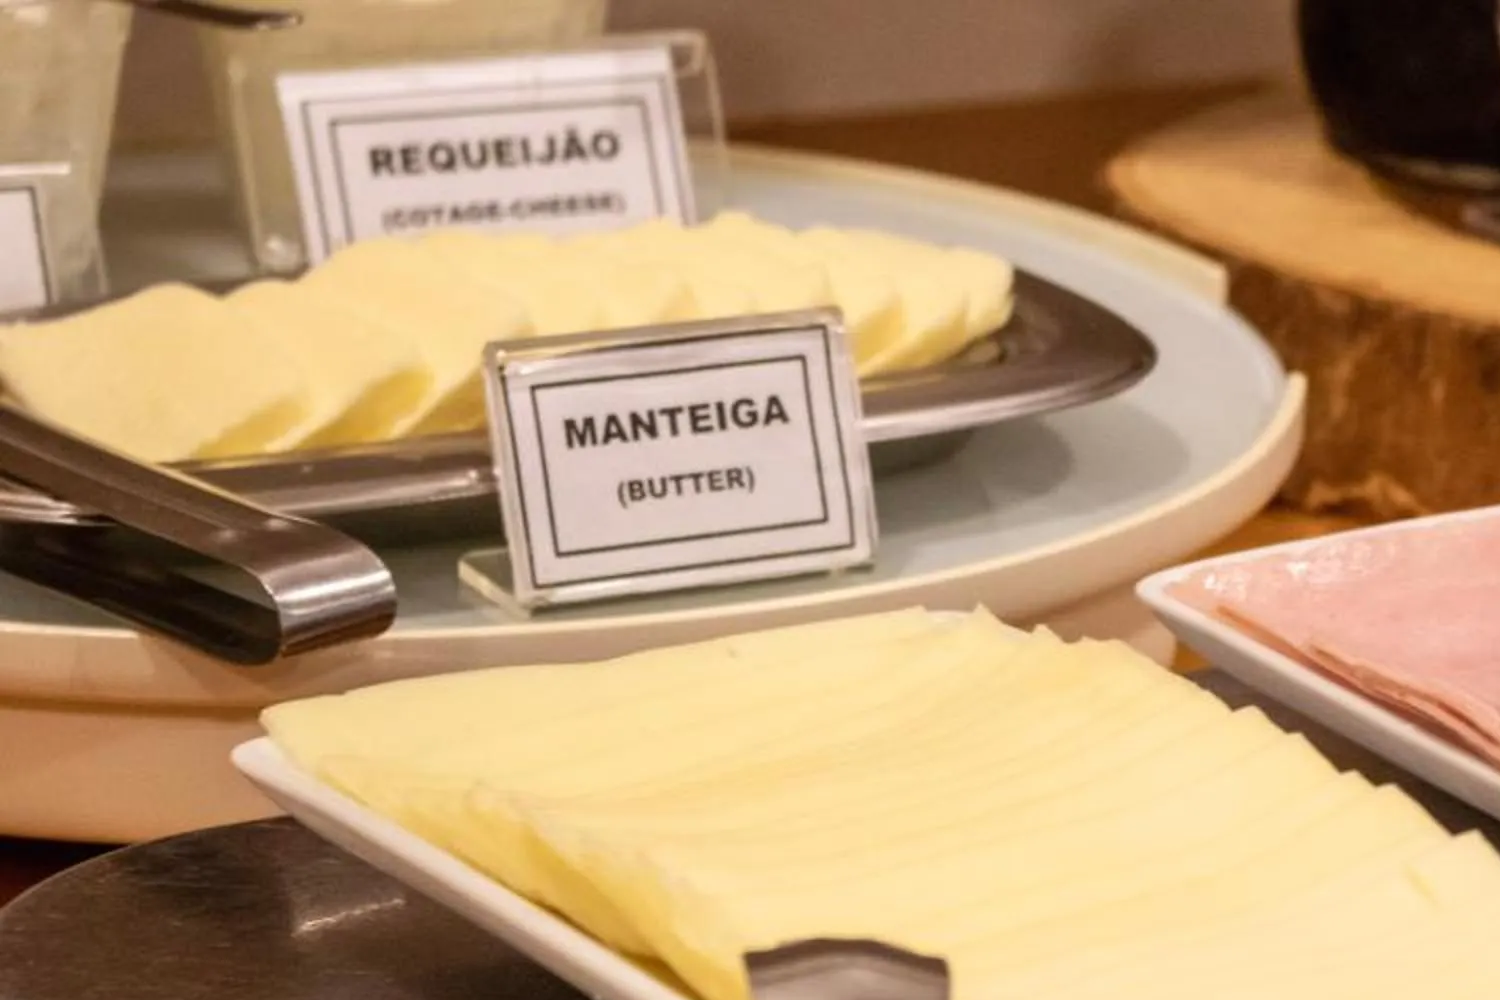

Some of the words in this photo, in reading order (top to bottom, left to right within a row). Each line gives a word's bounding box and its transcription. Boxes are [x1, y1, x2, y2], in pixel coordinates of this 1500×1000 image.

[368, 126, 620, 176] REQUEIJÃO
[563, 394, 790, 449] MANTEIGA
[617, 466, 756, 509] (BUTTER)
